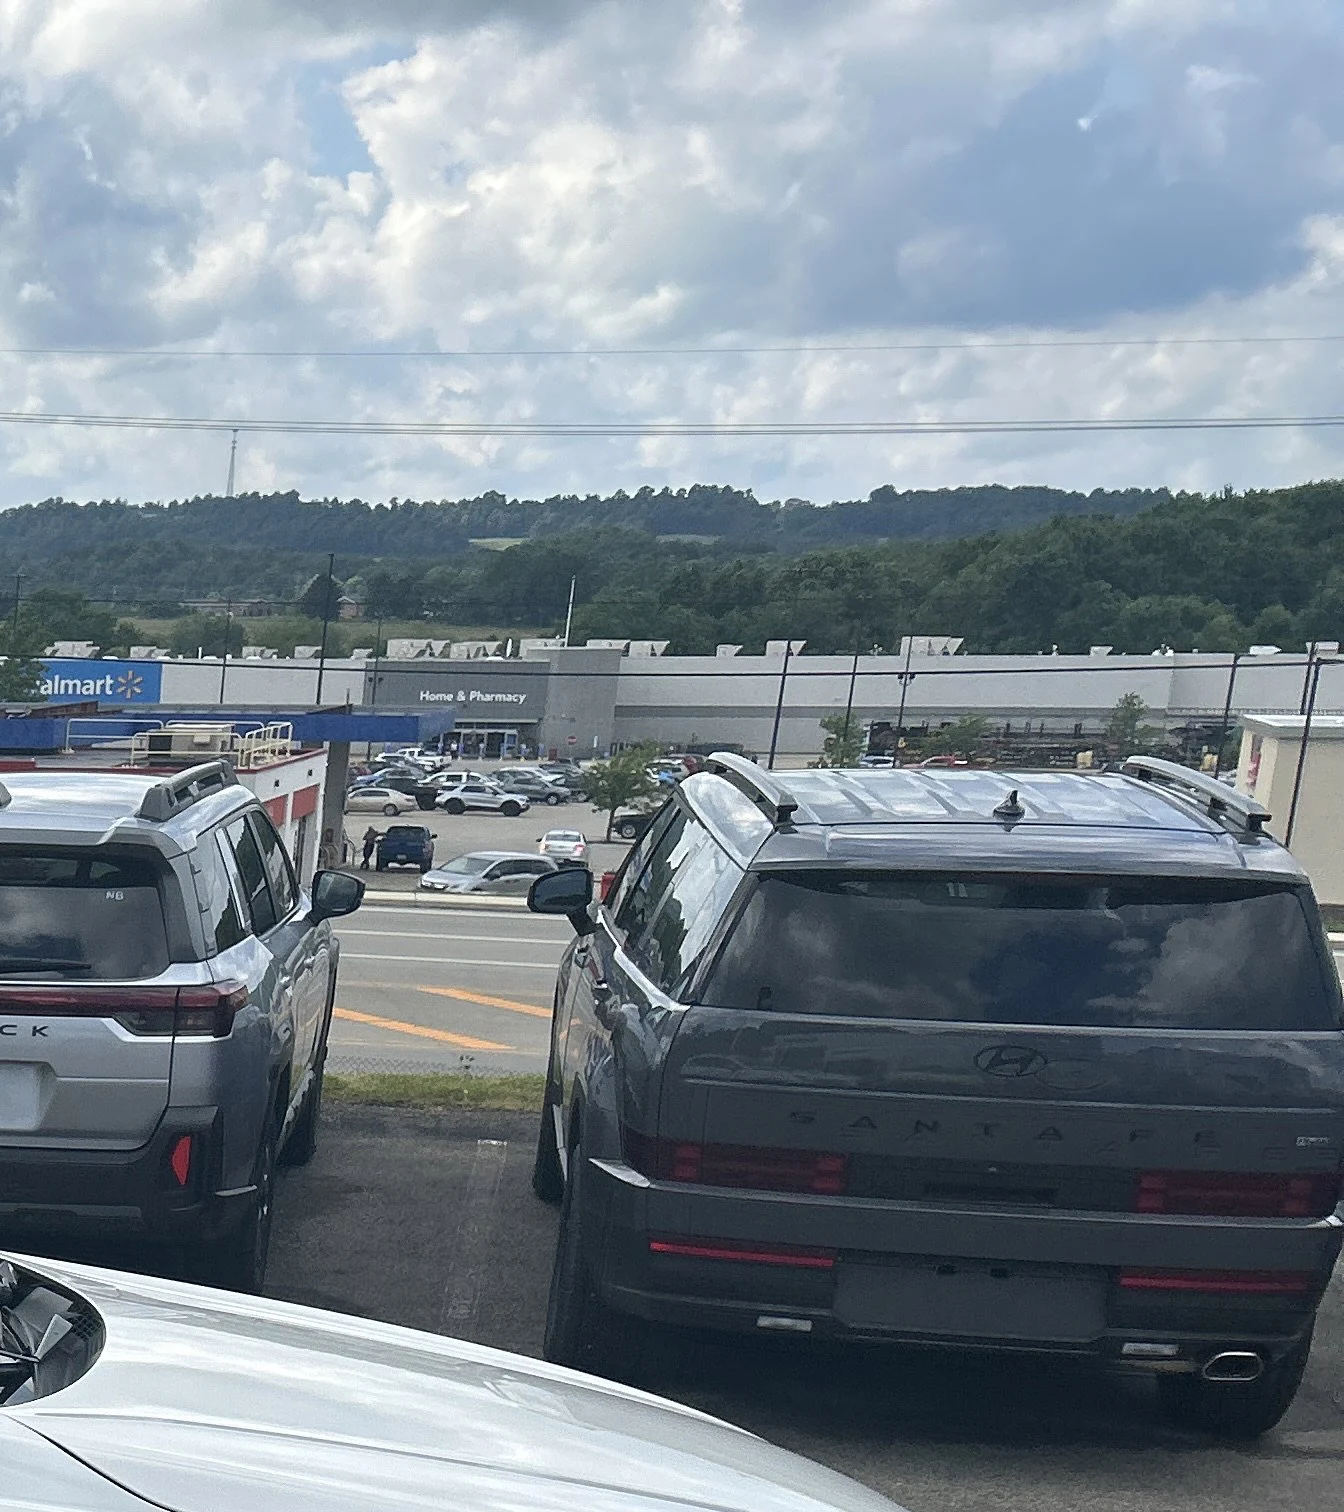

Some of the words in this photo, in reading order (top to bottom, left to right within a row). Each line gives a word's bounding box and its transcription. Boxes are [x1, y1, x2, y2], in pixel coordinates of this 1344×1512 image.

[39, 674, 114, 696] almart
[419, 690, 454, 702] Home
[457, 690, 466, 702] &
[469, 690, 527, 705] Pharmacy
[789, 1110, 1064, 1142] SANTA
